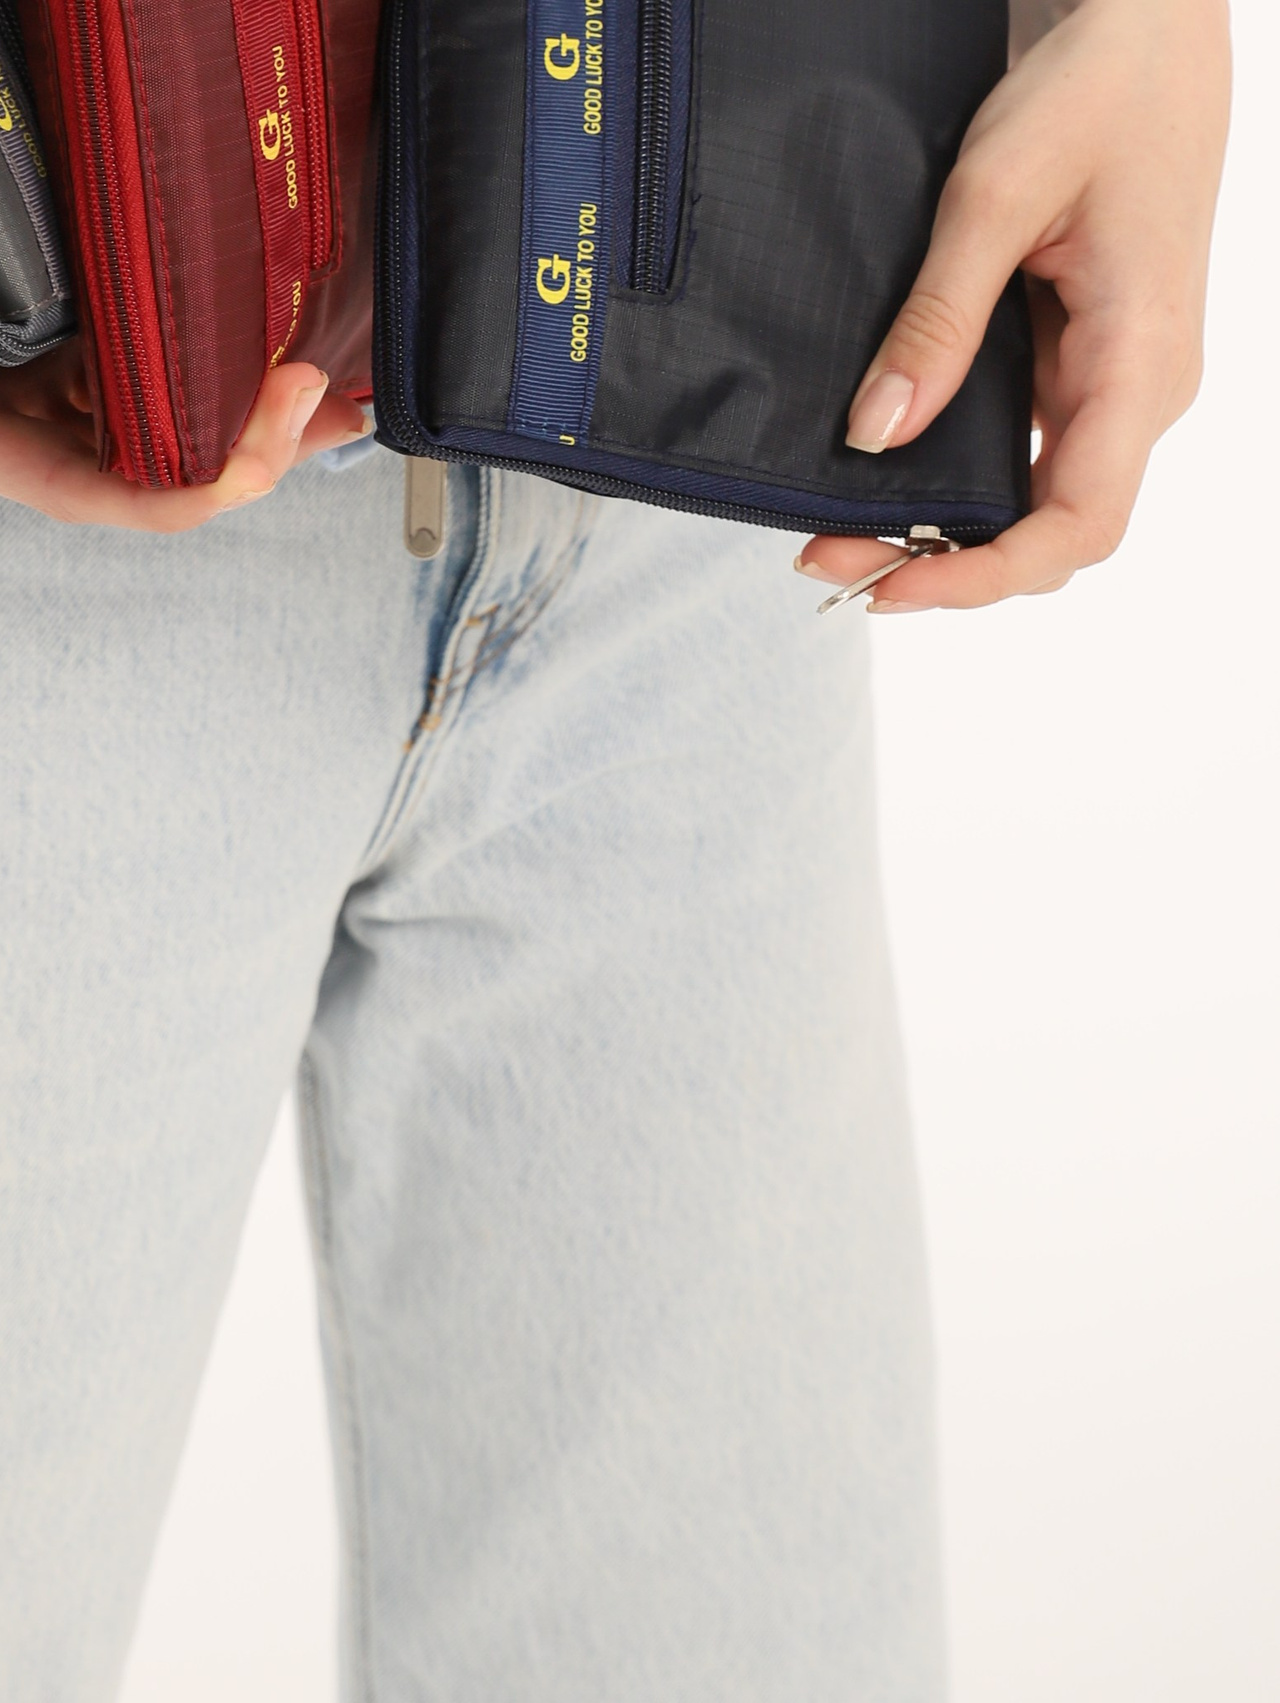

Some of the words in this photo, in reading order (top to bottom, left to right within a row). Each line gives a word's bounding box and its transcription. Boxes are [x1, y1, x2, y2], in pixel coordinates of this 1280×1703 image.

[585, 19, 603, 39] TO
[272, 45, 286, 82] YOU
[544, 33, 580, 80] G
[585, 43, 603, 85] LUCK
[277, 85, 288, 109] TO
[583, 88, 602, 135] GOOD
[23, 132, 47, 178] GOOD
[258, 109, 281, 160] G
[280, 111, 294, 156] LUCK
[286, 159, 298, 208] GOOD
[578, 203, 597, 236] YOU
[577, 239, 595, 261] TO
[536, 254, 570, 304] G
[574, 266, 593, 310] LUCK
[570, 313, 590, 362] GOOD
